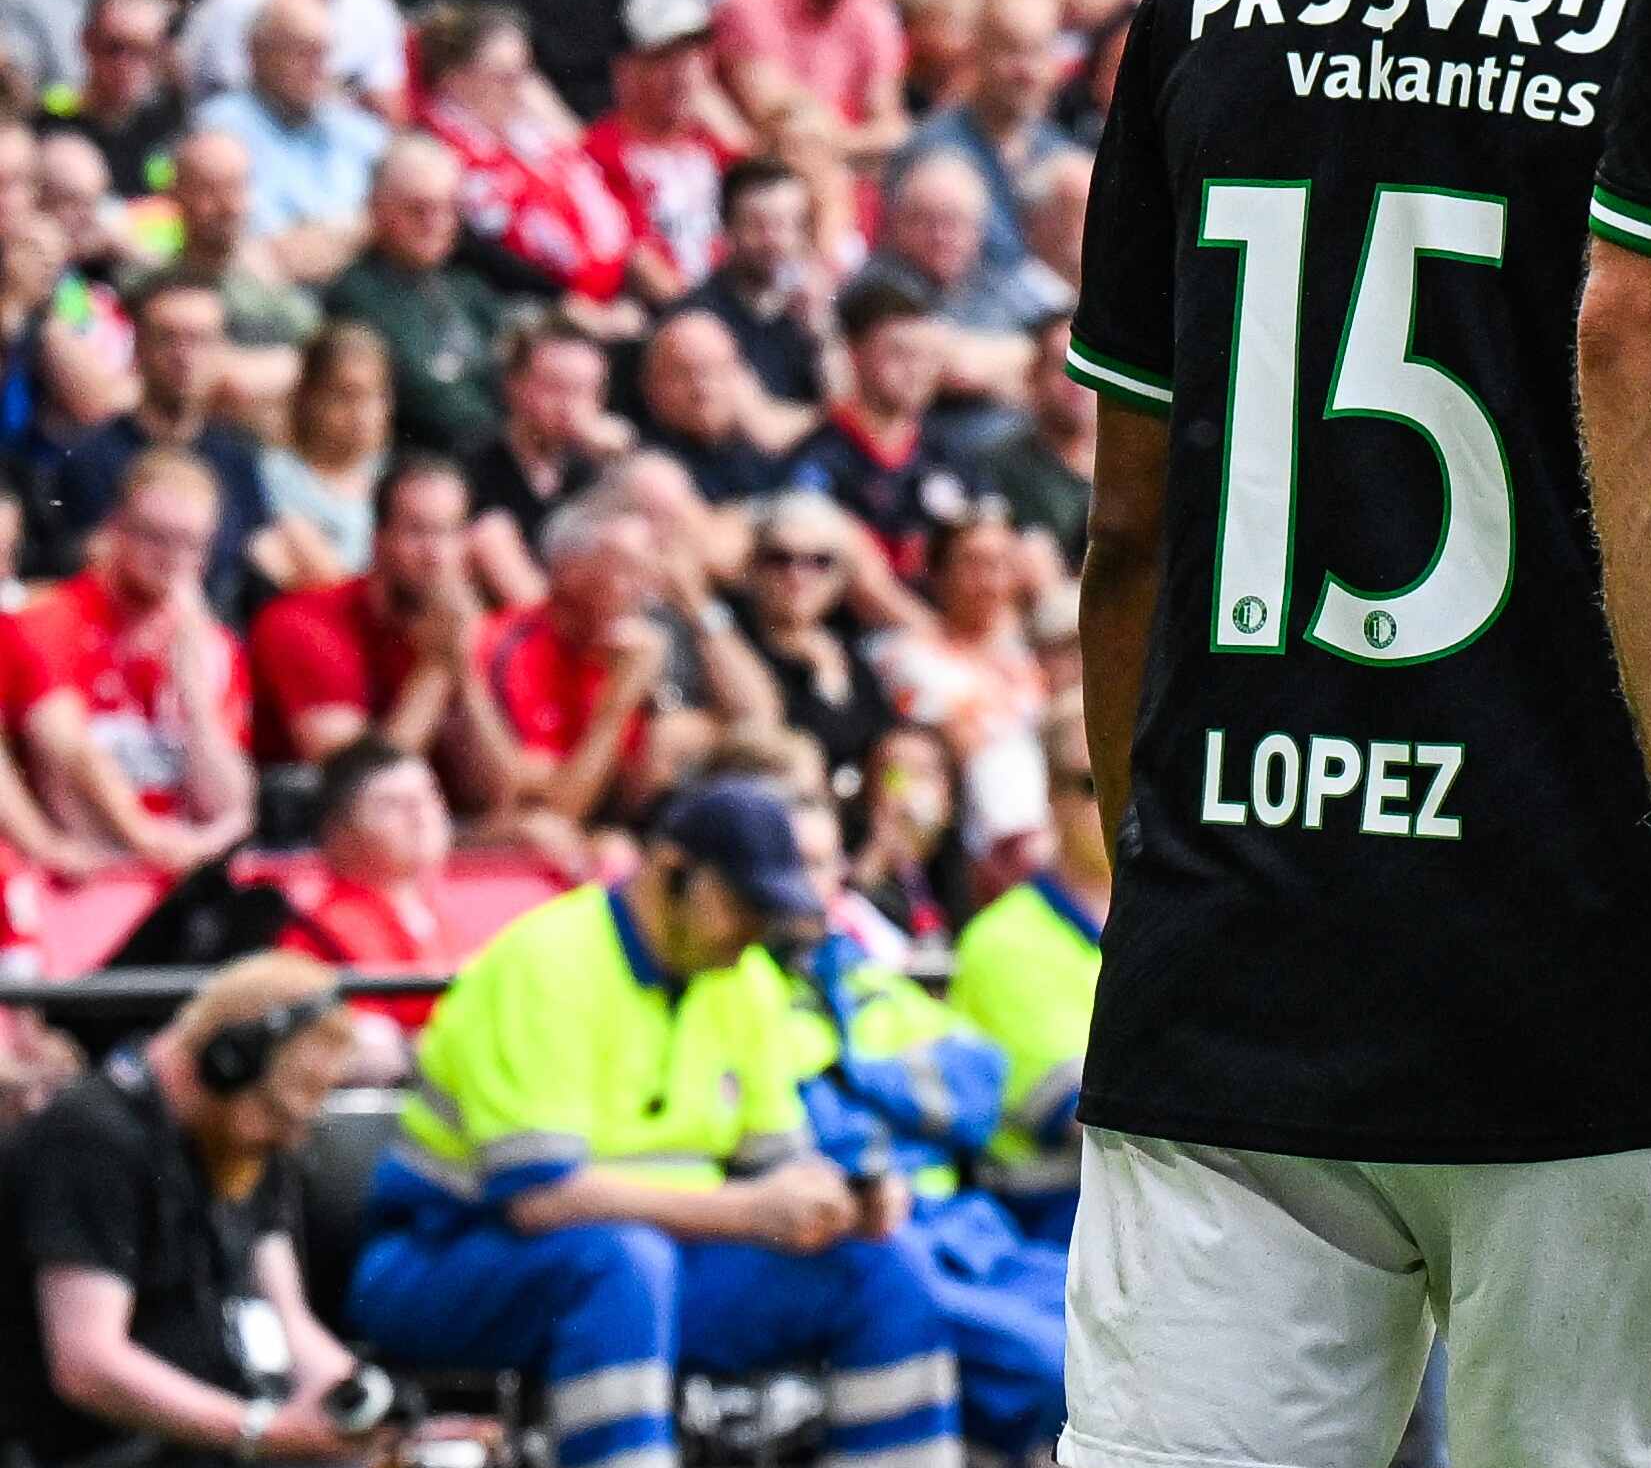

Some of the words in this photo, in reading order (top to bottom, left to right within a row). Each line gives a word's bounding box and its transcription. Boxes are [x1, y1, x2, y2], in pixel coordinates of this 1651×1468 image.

[1286, 41, 1600, 127] vakanties
[1197, 178, 1515, 667] 15
[1201, 730, 1464, 839] LOPEZ
